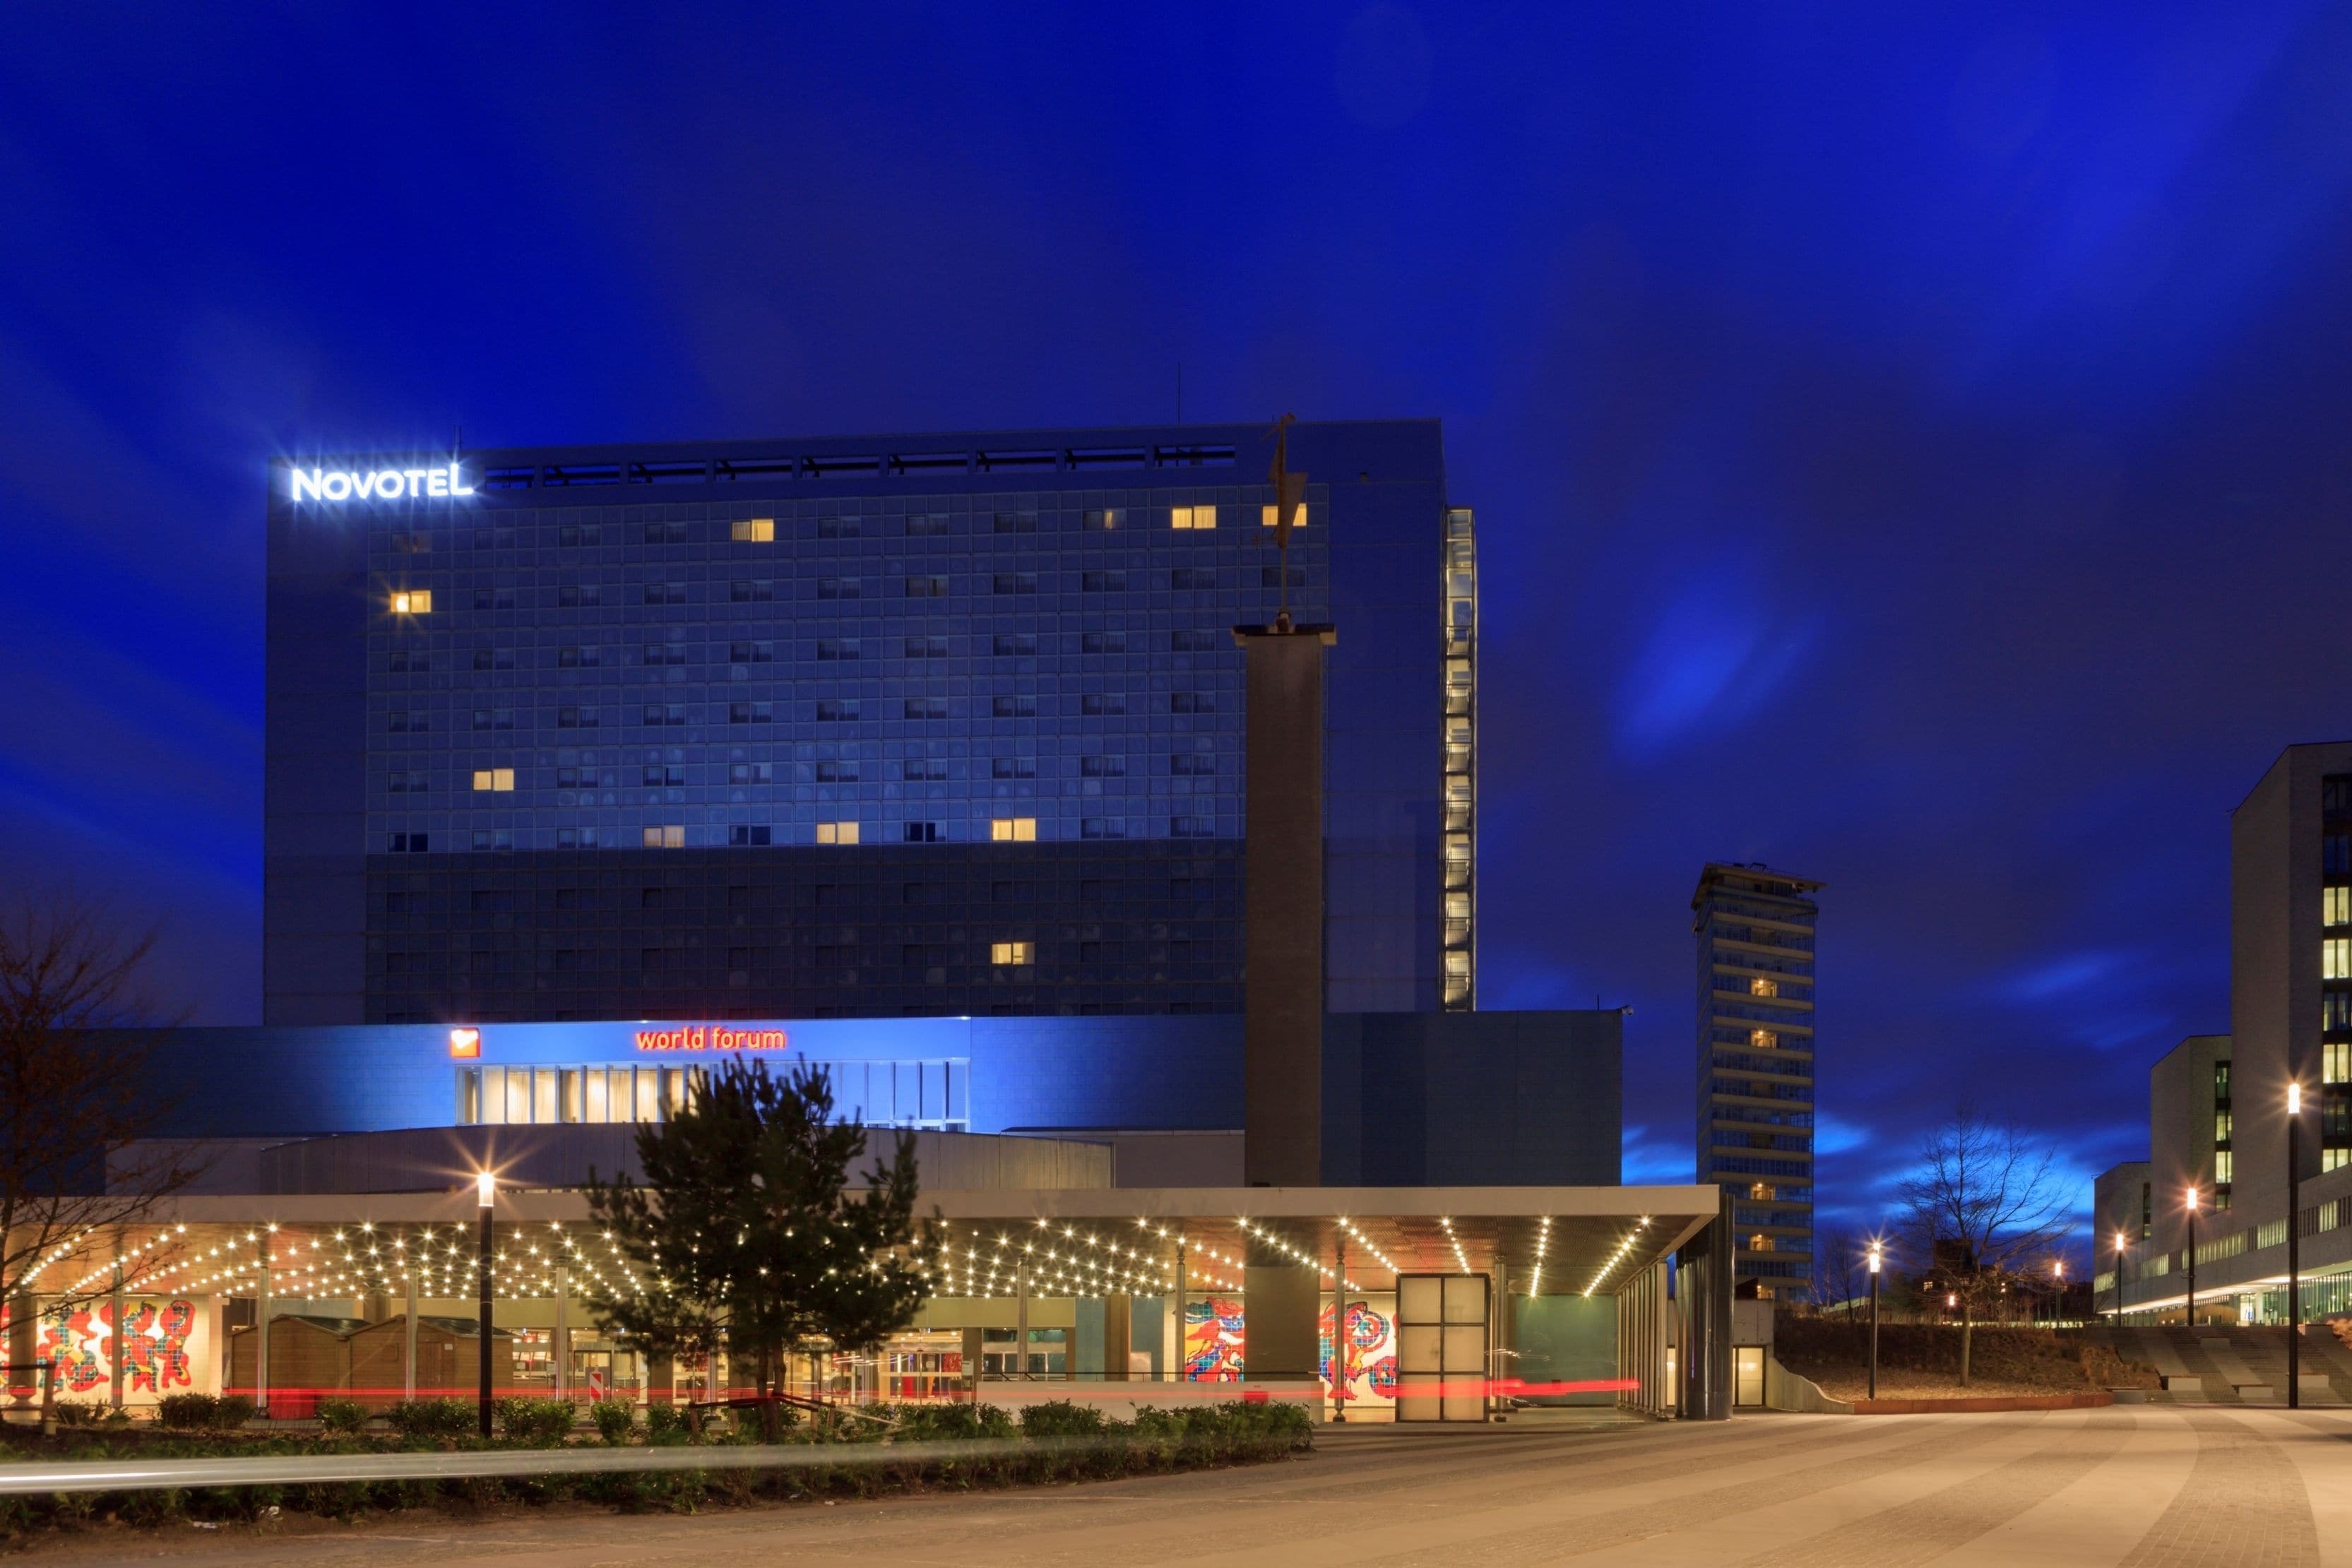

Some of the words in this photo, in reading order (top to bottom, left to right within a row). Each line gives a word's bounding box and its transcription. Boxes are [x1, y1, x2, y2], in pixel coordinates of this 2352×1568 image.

[292, 463, 474, 501] NOVOTEL
[636, 1027, 706, 1050] world
[712, 1026, 786, 1049] forum
